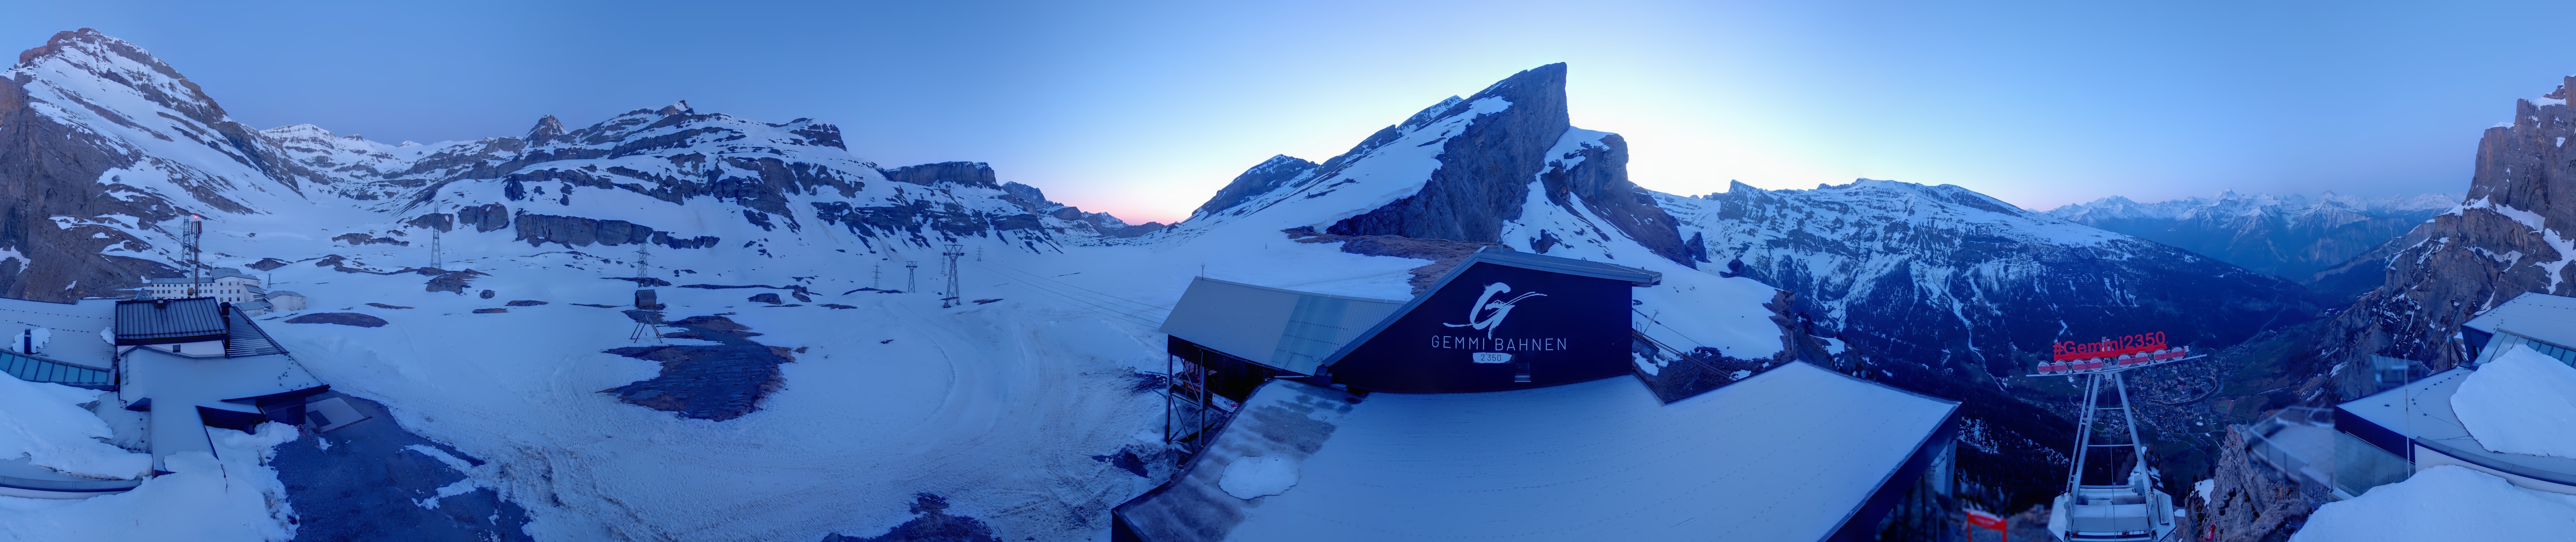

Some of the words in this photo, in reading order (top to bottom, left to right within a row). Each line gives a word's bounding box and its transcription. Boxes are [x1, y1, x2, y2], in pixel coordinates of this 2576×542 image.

[1432, 335, 1484, 350] GEMMI
[1495, 338, 1566, 351] BAHNEN
[2053, 331, 2165, 355] #Gemmi2350
